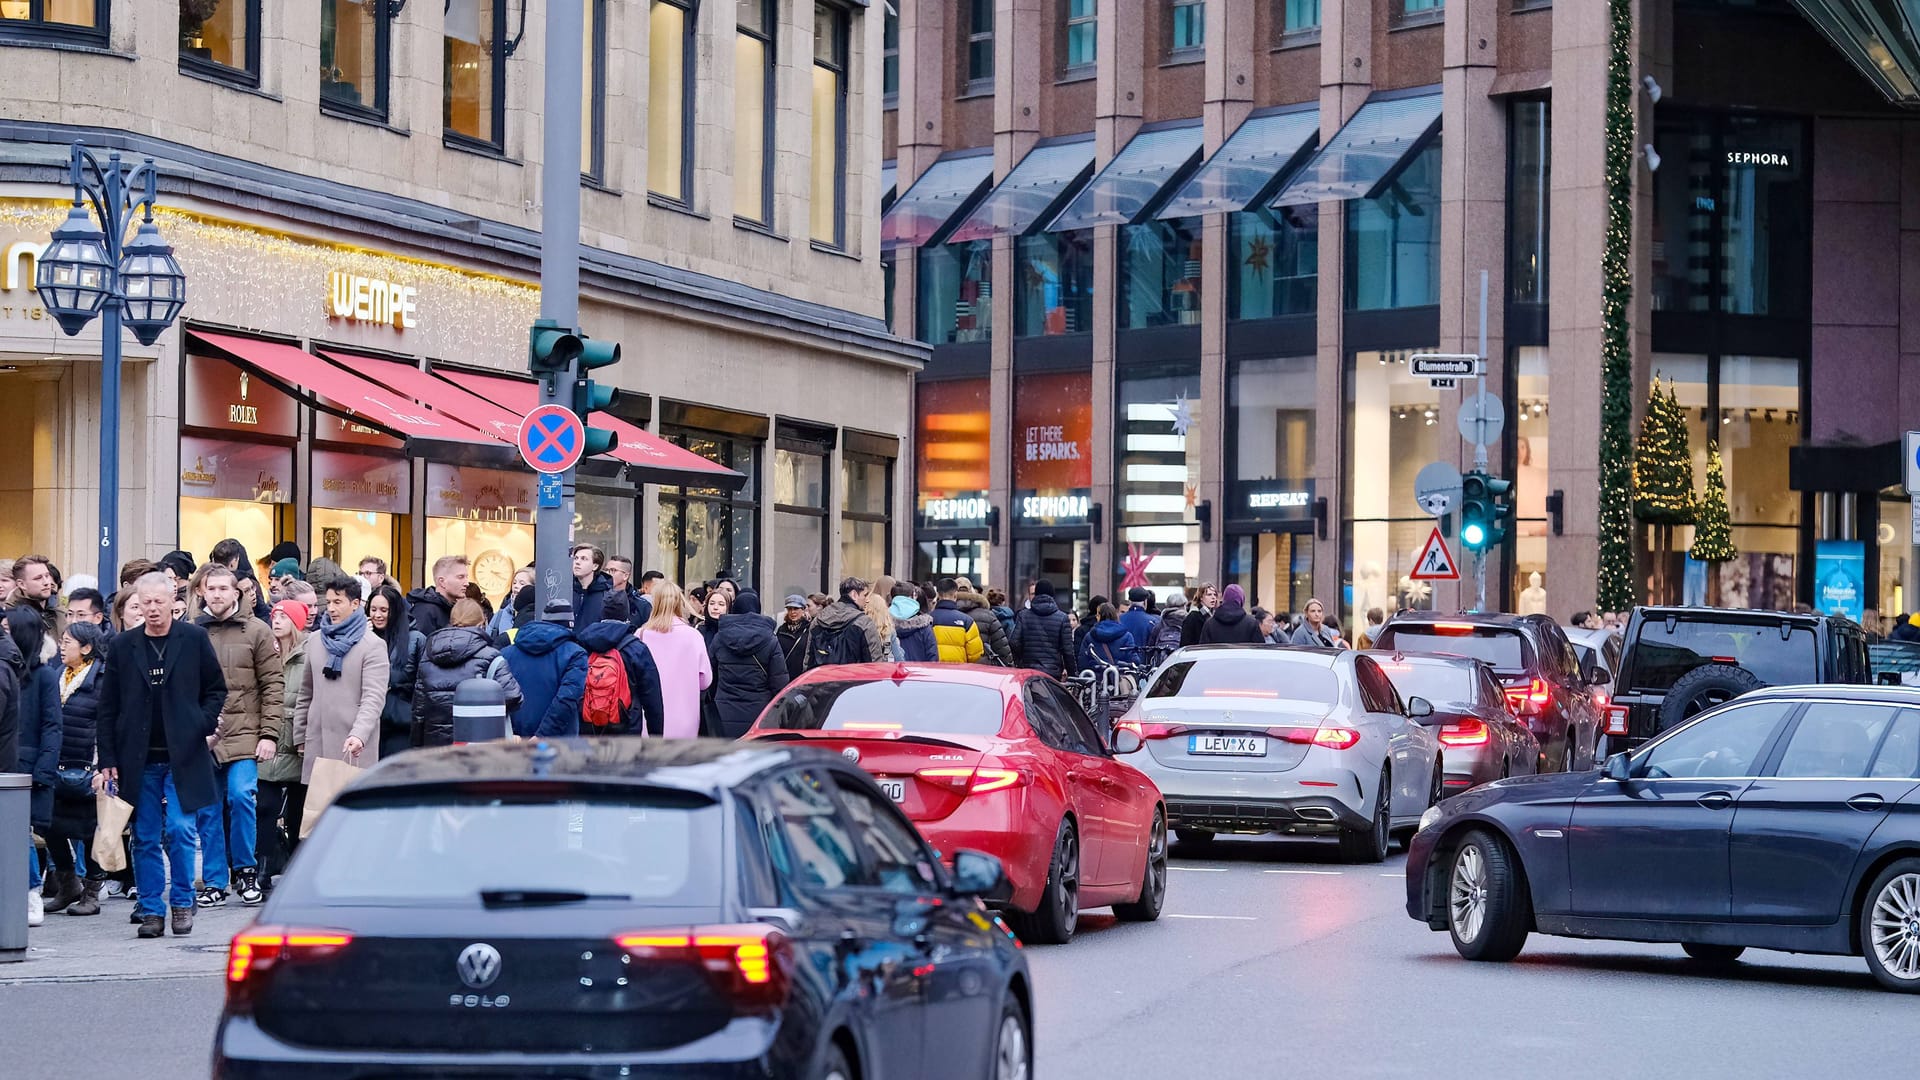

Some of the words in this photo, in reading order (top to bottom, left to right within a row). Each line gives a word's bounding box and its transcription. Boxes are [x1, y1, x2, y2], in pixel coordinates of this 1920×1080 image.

[1727, 152, 1789, 166] SEPHORA
[330, 271, 417, 328] WEMPE
[1418, 360, 1469, 372] Blumenstraße
[229, 404, 258, 425] ROLEX
[1026, 427, 1038, 442] LET
[1040, 425, 1063, 442] THERE
[1026, 443, 1036, 461] BE
[1039, 442, 1080, 461] SPARKS.
[1023, 496, 1088, 518] SEPHORA
[1249, 492, 1309, 507] REPEAT
[1204, 737, 1231, 751] LEV
